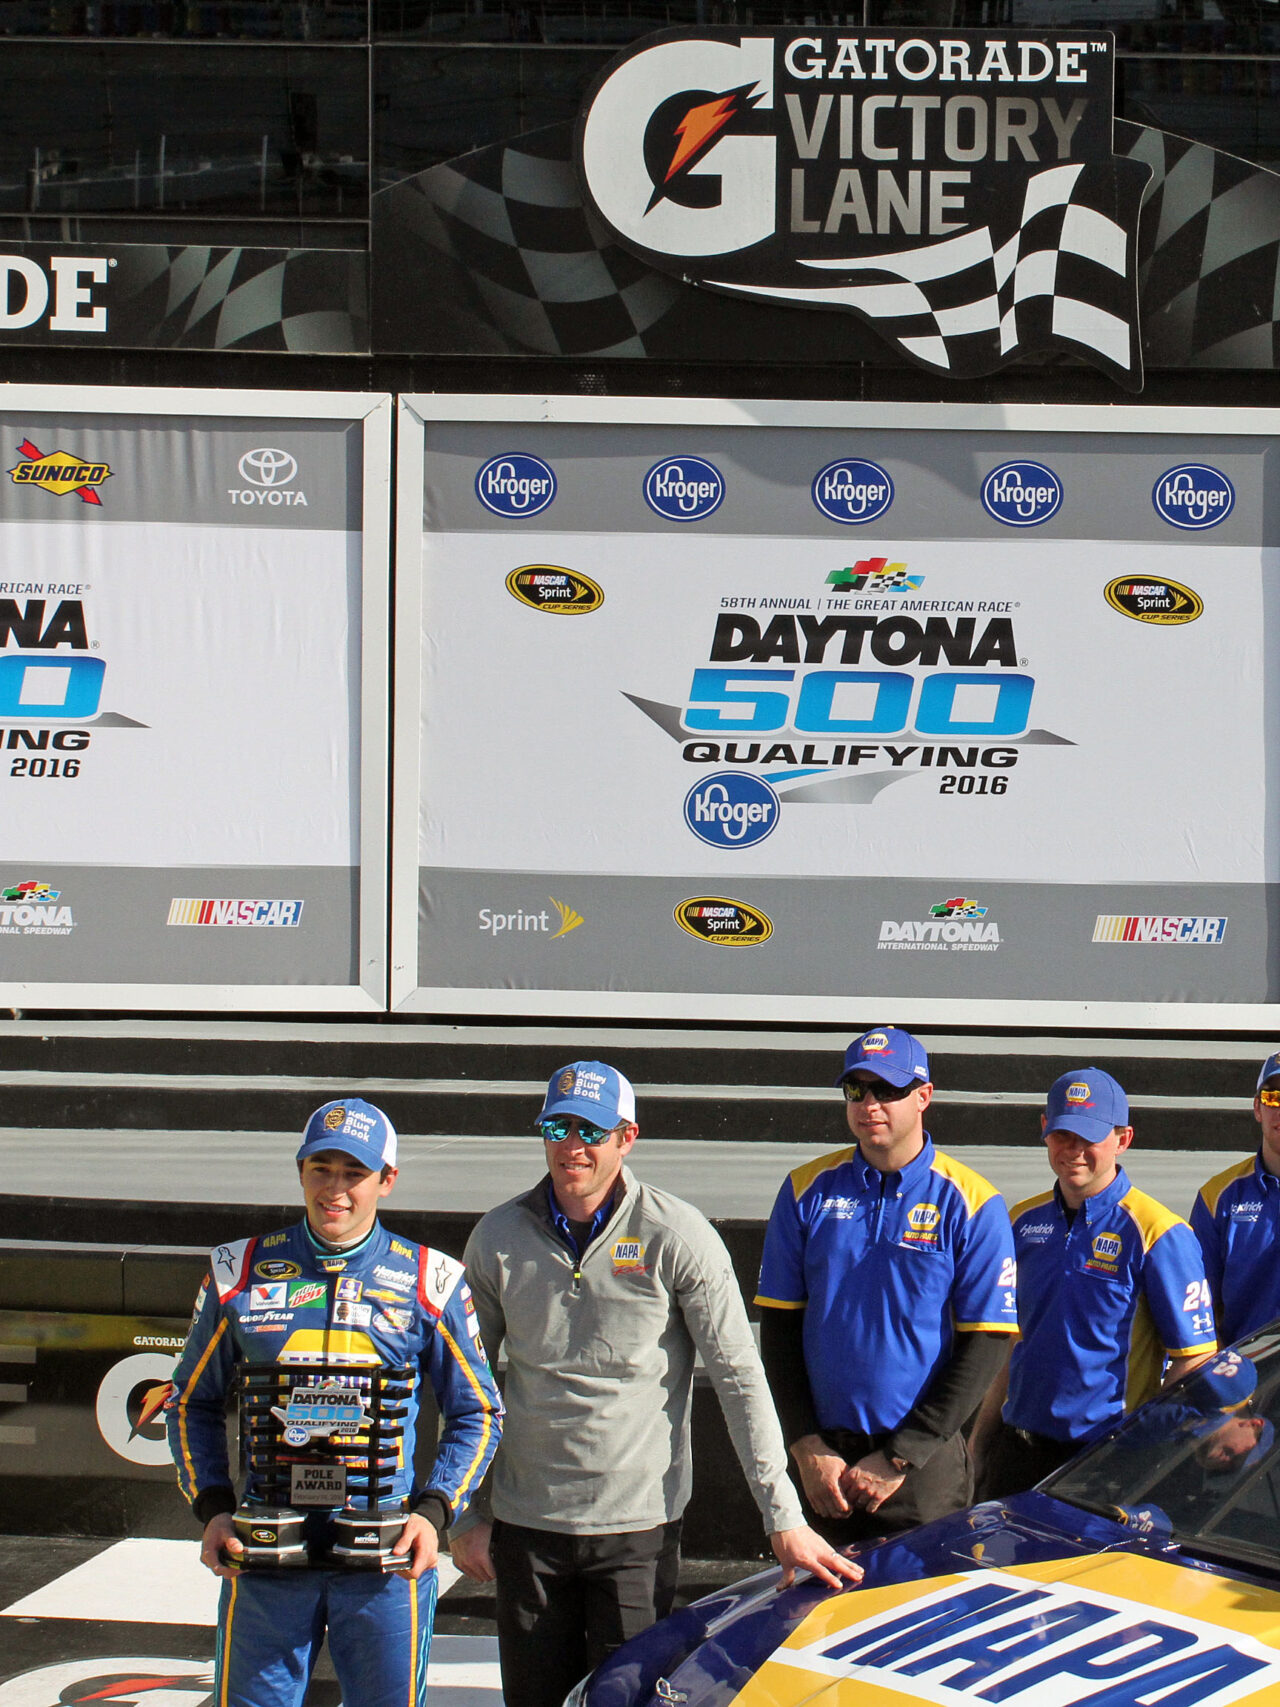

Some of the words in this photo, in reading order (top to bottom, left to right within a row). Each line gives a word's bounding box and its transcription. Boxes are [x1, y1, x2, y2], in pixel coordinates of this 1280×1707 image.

[784, 37, 1088, 83] GATORADE
[784, 93, 1088, 163] VICTORY
[582, 37, 777, 257] G
[790, 168, 972, 236] LANE
[16, 464, 105, 483] SUNOCO
[487, 462, 549, 509] Kroger
[656, 465, 718, 512] Kroger
[824, 468, 886, 515] Kroger
[228, 489, 309, 506] TOYOTA
[993, 471, 1055, 518] Kroger
[1165, 473, 1227, 520] Kroger
[533, 575, 567, 586] NASCAR
[47, 583, 83, 595] RACE
[538, 586, 572, 599] Sprint
[1131, 585, 1166, 596] NASCAR
[562, 603, 592, 611] SERIES
[720, 597, 757, 608] 58TH
[760, 598, 813, 610] ANNUAL
[826, 599, 852, 610] THE
[854, 599, 898, 611] GREAT
[899, 600, 974, 612] AMERICAN
[977, 601, 1013, 613] RACE
[1137, 596, 1171, 609] Sprint
[709, 613, 1018, 667] DAYTONA
[684, 667, 1036, 735] 500
[682, 743, 1019, 768] QUALIFYING
[10, 757, 82, 779] 2016
[939, 774, 1009, 796] 2016
[695, 783, 772, 840] Kroger
[211, 900, 297, 926] NASCAR
[701, 906, 736, 918] NASCAR
[478, 908, 549, 936] Sprint
[707, 917, 740, 931] Sprint
[1134, 917, 1219, 942] NASCAR
[23, 926, 73, 936] SPEEDWAY
[730, 935, 762, 943] SERIES
[879, 920, 1000, 943] DAYTONA
[877, 942, 948, 951] INTERNATIONAL
[951, 943, 999, 952] SPEEDWAY
[865, 1037, 885, 1046] NAPA
[576, 1078, 600, 1091] Blue
[577, 1070, 607, 1085] Kelley
[573, 1087, 602, 1100] Book
[1068, 1087, 1086, 1097] NAPA
[345, 1117, 370, 1132] Blue
[348, 1110, 377, 1127] Kelley
[342, 1125, 370, 1143] Book
[912, 1208, 938, 1224] NAPA
[390, 1240, 413, 1260] NAPA
[615, 1243, 640, 1259] NAPA
[1095, 1237, 1120, 1256] NAPA
[1183, 1278, 1212, 1312] 24
[239, 1311, 295, 1323] GOODYEAR
[133, 1336, 186, 1346] GATORAD
[293, 1394, 359, 1405] DAYTONA
[286, 1405, 363, 1420] 500
[304, 1470, 333, 1479] POLE
[295, 1480, 342, 1490] AWARD
